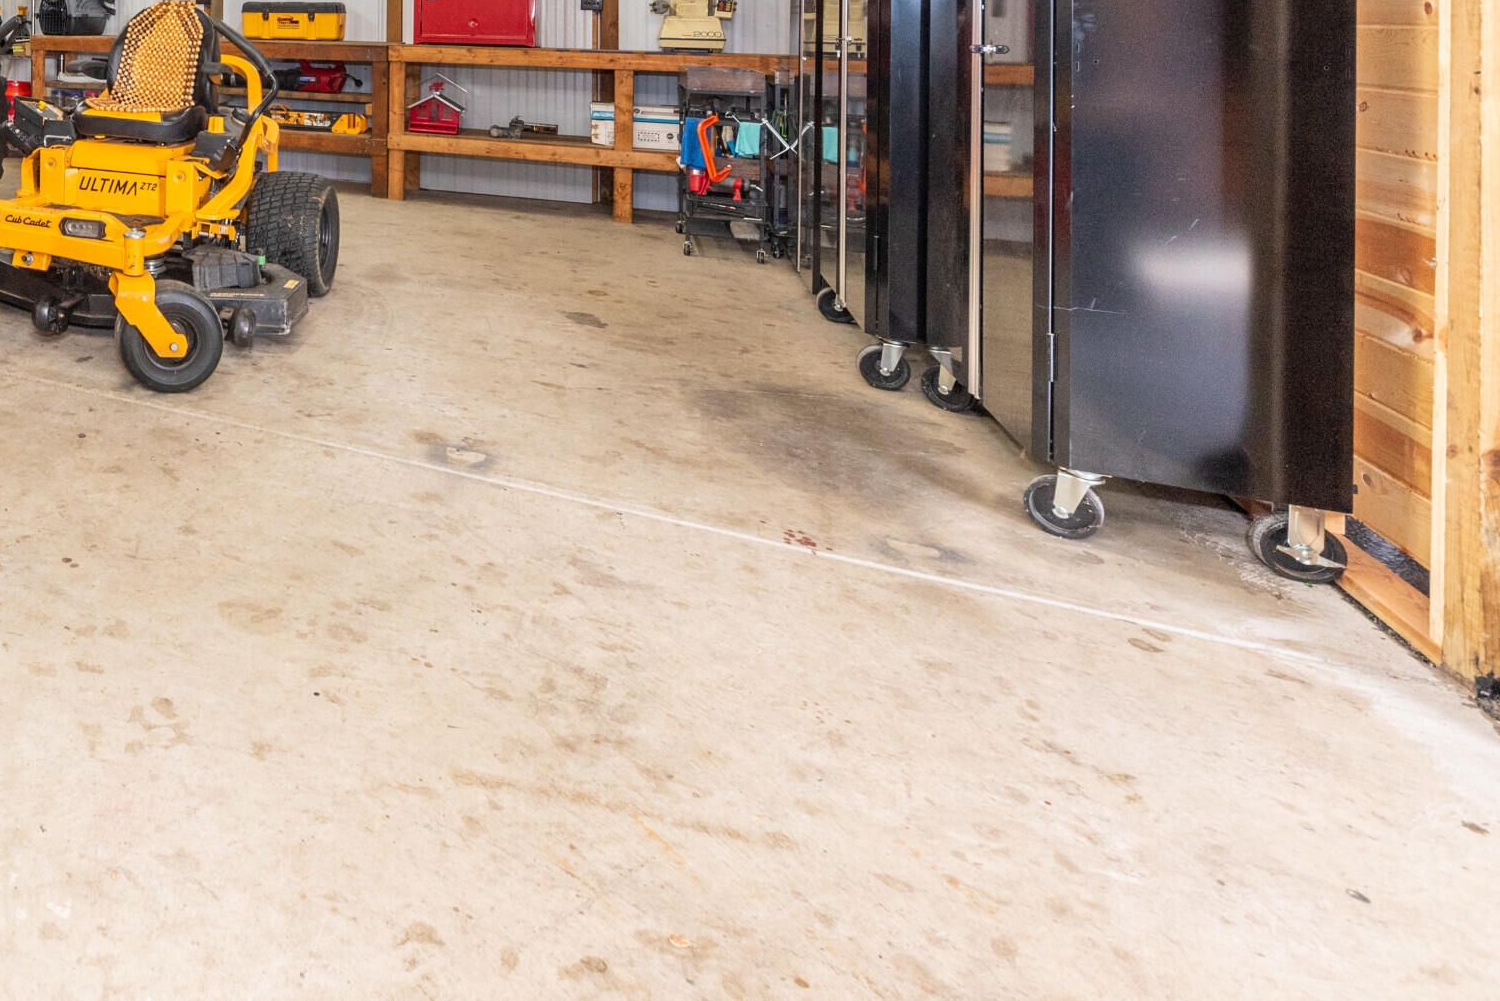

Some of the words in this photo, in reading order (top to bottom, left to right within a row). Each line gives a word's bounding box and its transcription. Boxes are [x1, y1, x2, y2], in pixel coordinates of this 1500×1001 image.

[79, 175, 137, 196] ULTIMA
[139, 181, 158, 192] ZT2
[5, 213, 22, 224] Cub
[23, 216, 52, 228] Cadet
